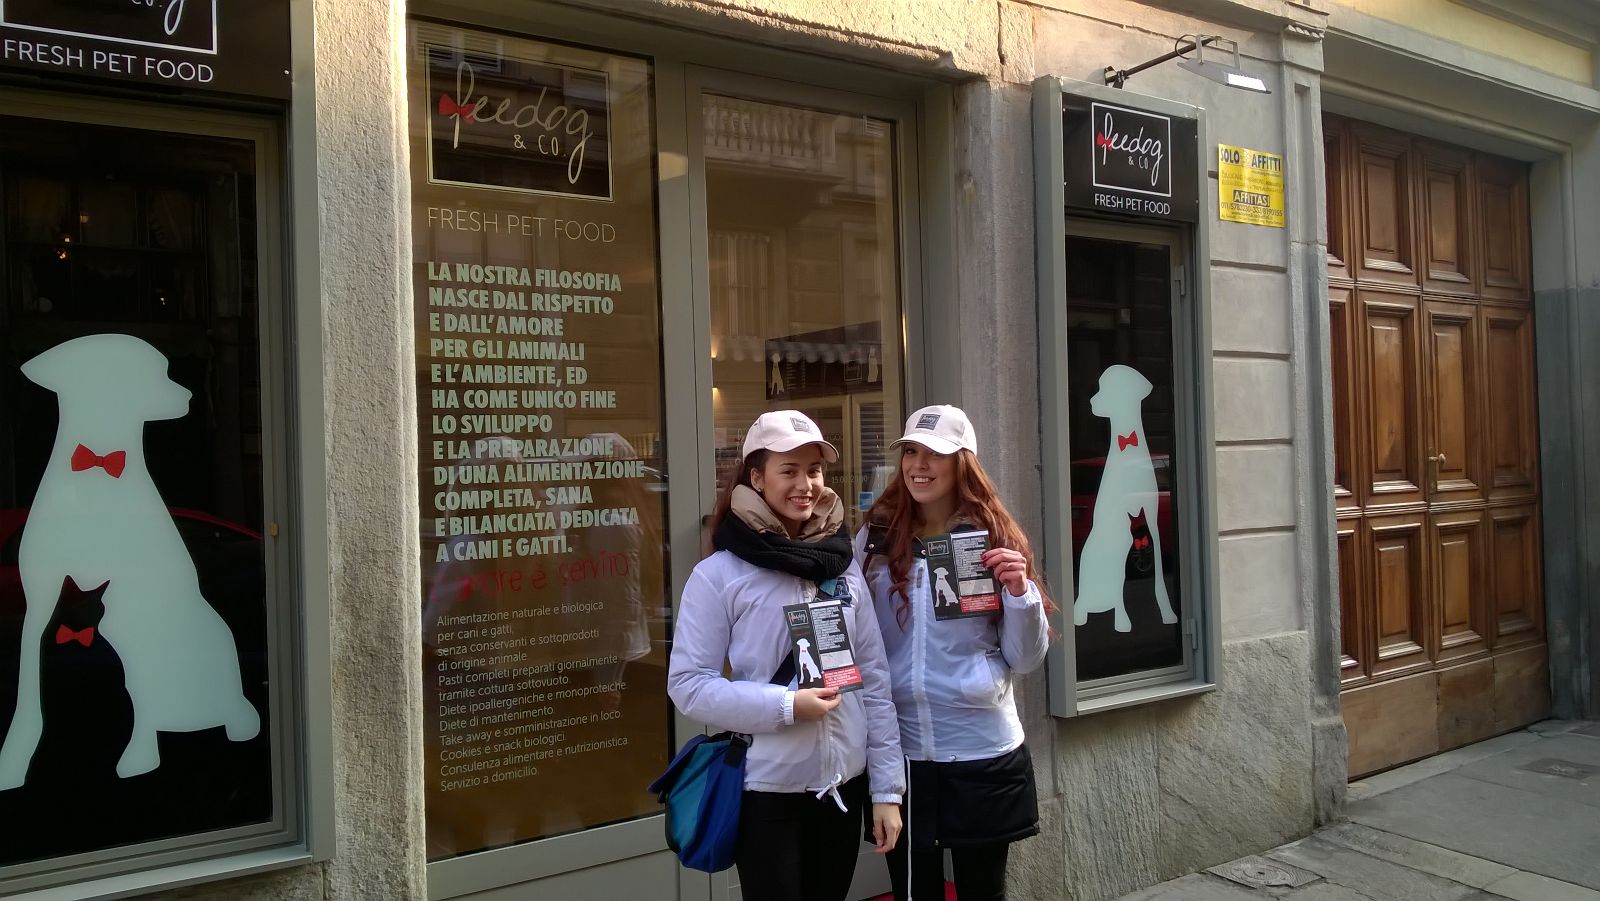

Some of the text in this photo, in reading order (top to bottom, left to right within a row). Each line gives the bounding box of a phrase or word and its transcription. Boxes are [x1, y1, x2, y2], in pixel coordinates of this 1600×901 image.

[4, 39, 214, 83] FRESH PET FOOD
[513, 134, 527, 150] &
[1220, 148, 1281, 171] SOLO AFFITTI
[1095, 193, 1170, 215] FRESH PET FOOD
[428, 207, 616, 243] FRESH PET FOOD
[428, 261, 622, 292] LA NOSTRA FILOSOFIA
[428, 287, 614, 315] NASCE DAL RISPETTO
[429, 312, 440, 332] E
[430, 338, 585, 361] PER GLI ANIMALI
[431, 364, 441, 383] E
[566, 367, 588, 385] ED
[431, 389, 617, 409] HA COME UNICO FINE
[432, 414, 553, 434] LO SVILUPPO
[433, 438, 614, 460] E LA PREPARAZIONE
[434, 460, 645, 486] DI UNA ALIMENTAZIONE
[434, 485, 593, 511] COMPLETA, SANA
[435, 507, 640, 537] E BILANCIATA DEDICATA
[435, 535, 573, 563] A CANI E GATTI.
[437, 600, 604, 627] Alimentazione naturale e biologica
[437, 631, 455, 645] per
[457, 627, 479, 640] cani
[481, 627, 488, 637] e
[437, 628, 600, 657] senza conservanti e sottoprodotti
[438, 651, 528, 672] di origine animale
[438, 654, 618, 686] Pasti completi preparati giornalmente
[438, 675, 569, 701] tramite cottura sottovuoto
[439, 680, 626, 717] Diete ipoallergeniche e monoproteiche
[439, 718, 467, 732] Diete
[469, 715, 479, 727] di
[440, 734, 463, 746] Take
[466, 728, 492, 743] away
[494, 729, 501, 738] e
[503, 714, 588, 736] somministrazione
[590, 712, 599, 723] in
[440, 747, 482, 762] Cookies
[484, 746, 490, 755] e
[493, 738, 521, 752] snack
[440, 757, 501, 777] Consulenza
[503, 749, 554, 766] alimentare
[556, 748, 563, 757] e
[440, 776, 480, 792] Servizio
[483, 775, 489, 785] a
